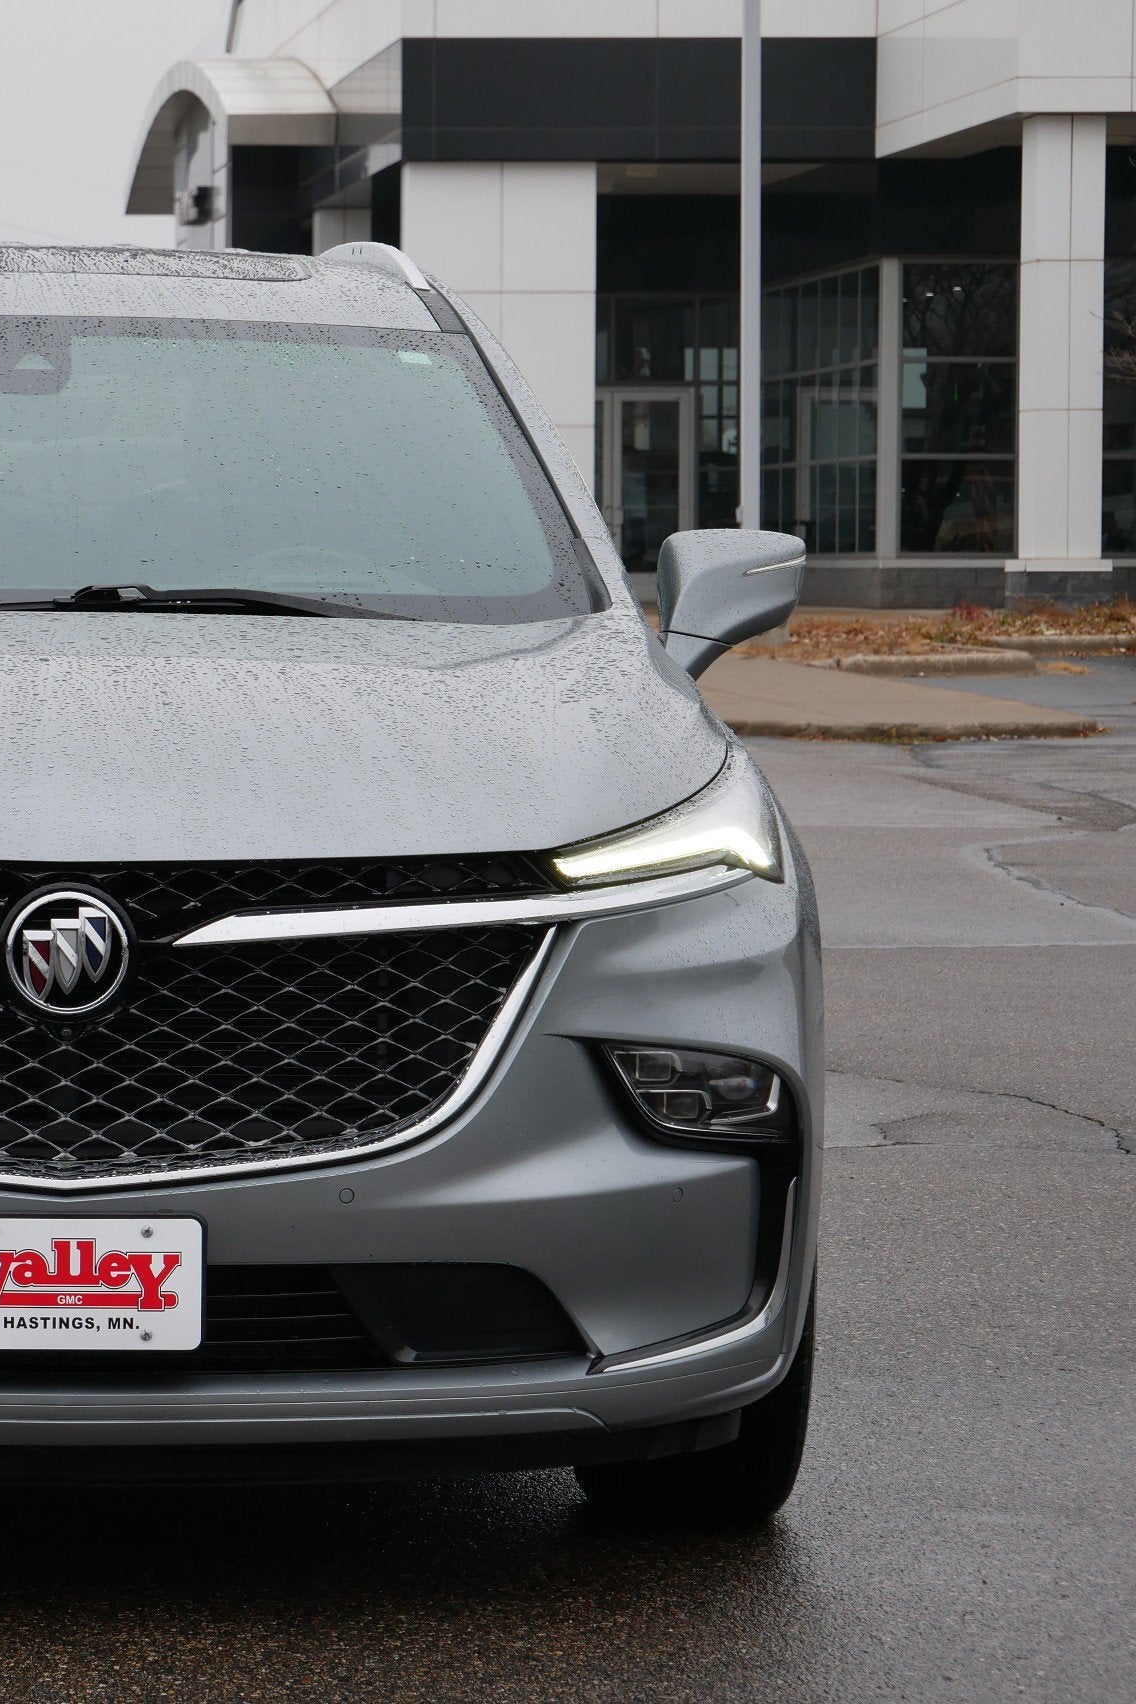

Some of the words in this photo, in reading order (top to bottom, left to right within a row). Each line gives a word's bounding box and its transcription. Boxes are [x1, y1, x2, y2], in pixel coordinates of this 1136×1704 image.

[57, 1294, 83, 1305] GMC
[3, 1316, 101, 1332] HASTINGS,
[107, 1317, 140, 1330] MN.
